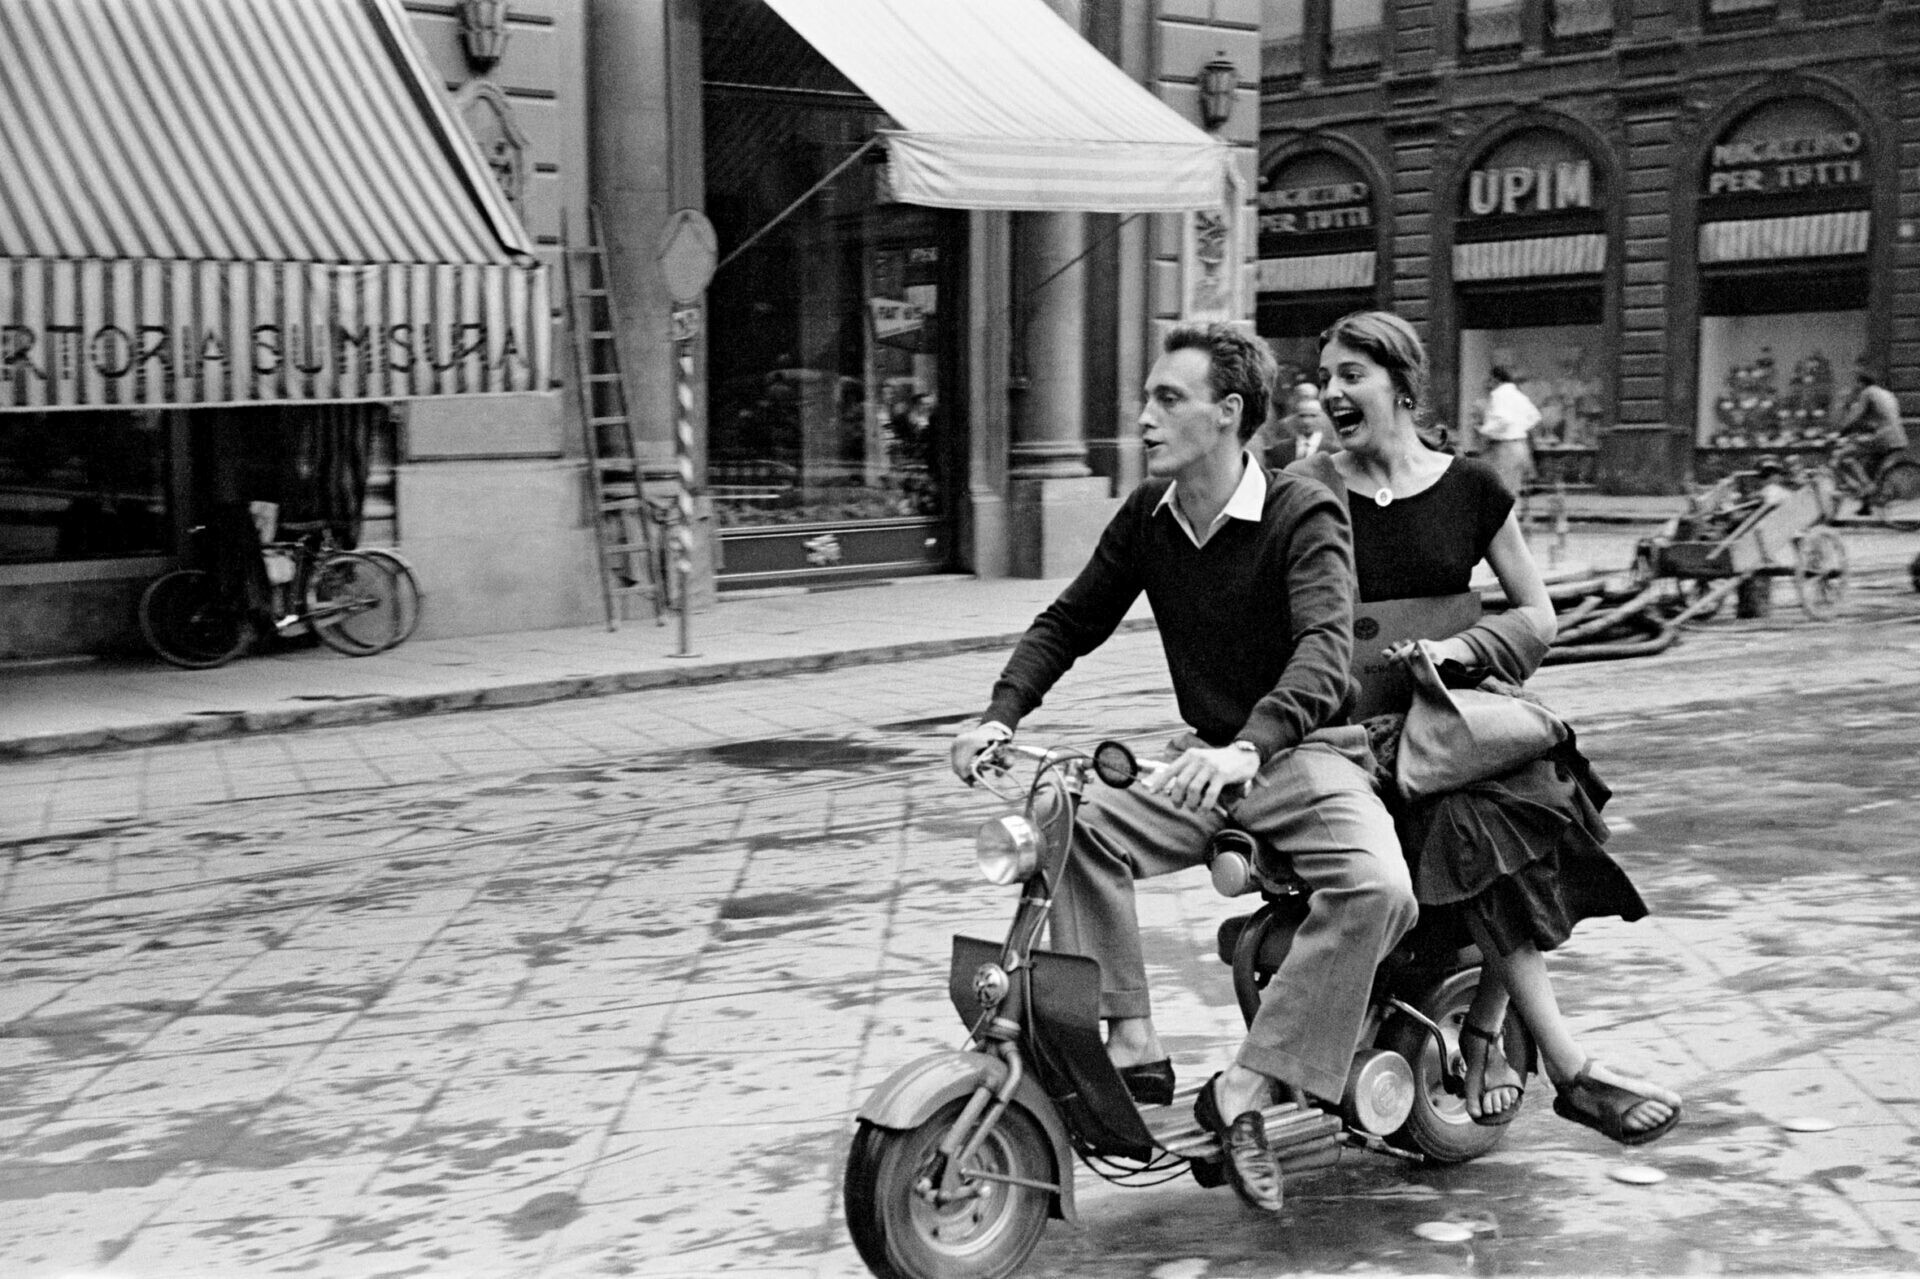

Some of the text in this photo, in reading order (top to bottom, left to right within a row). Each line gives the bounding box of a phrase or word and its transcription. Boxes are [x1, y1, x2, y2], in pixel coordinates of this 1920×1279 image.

[1469, 159, 1590, 214] UPIM
[1709, 160, 1861, 194] PER TUTTI
[1306, 206, 1369, 231] TUTTI
[1, 325, 231, 381] RTORIA
